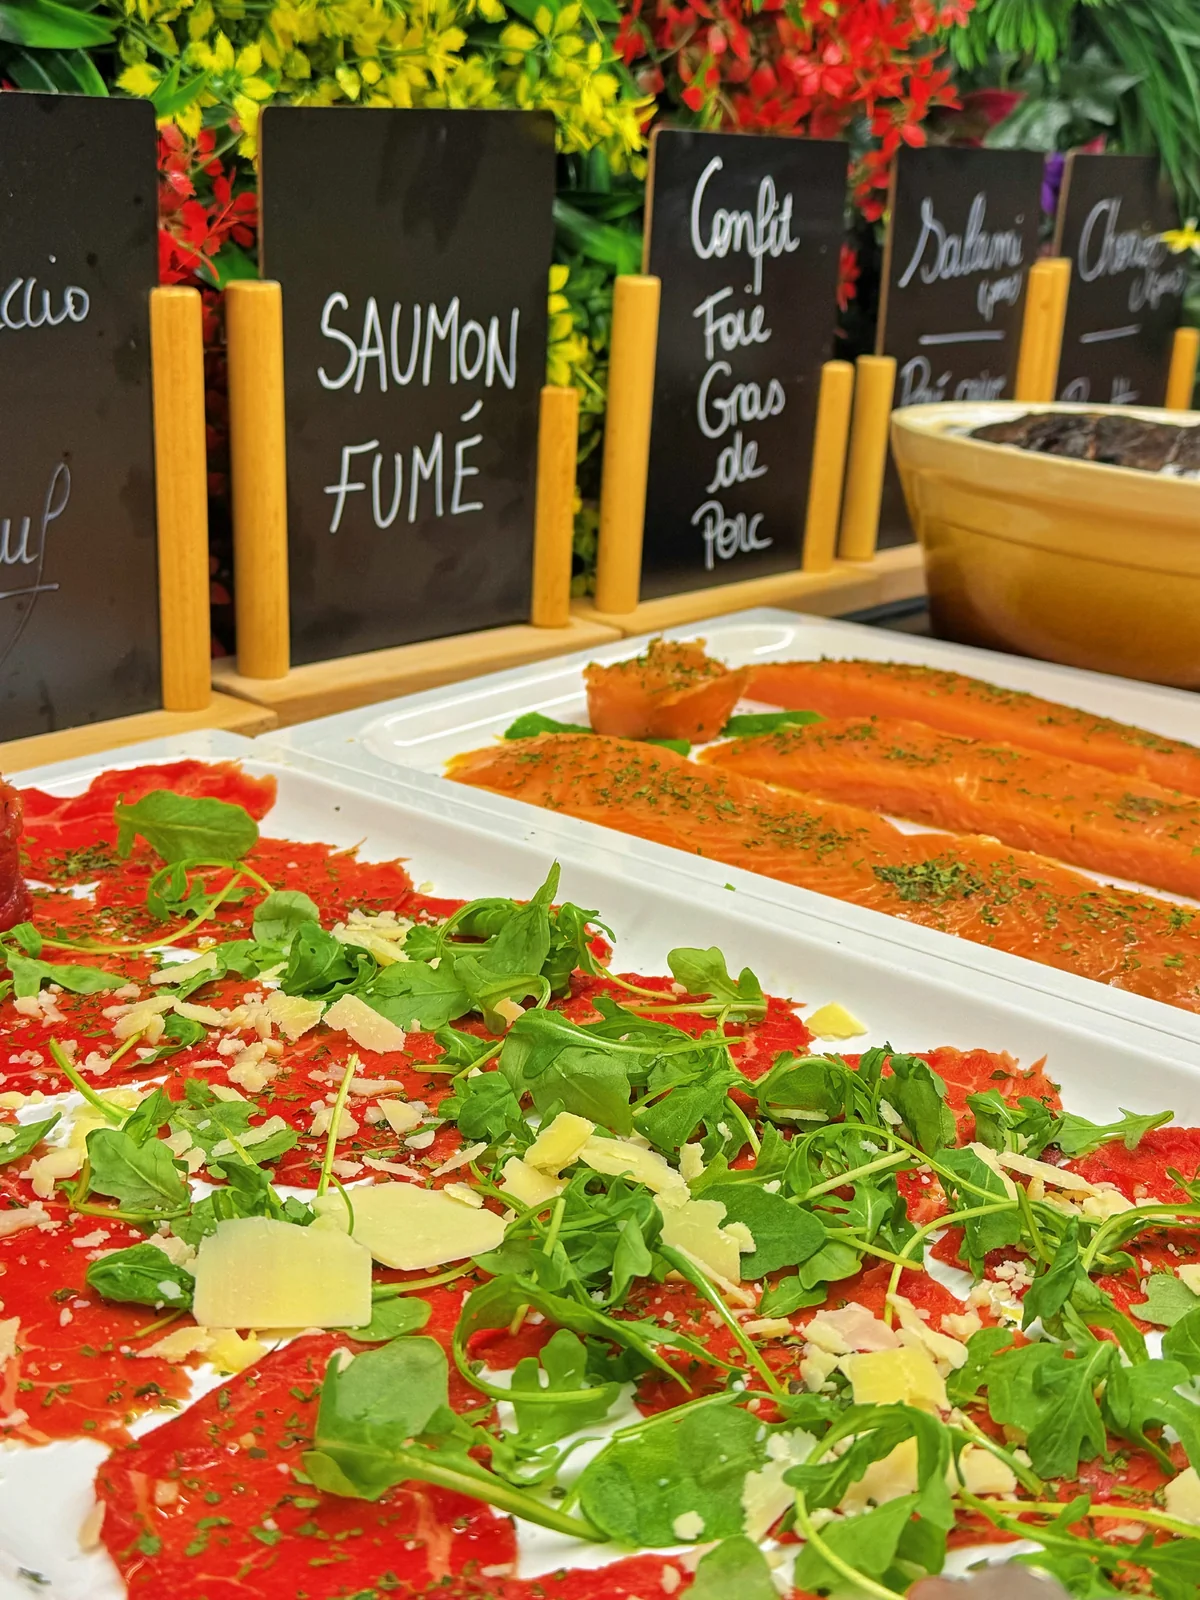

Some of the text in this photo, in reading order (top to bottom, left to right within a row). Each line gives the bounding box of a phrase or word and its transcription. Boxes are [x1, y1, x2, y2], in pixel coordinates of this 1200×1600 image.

[691, 155, 800, 296] Confit
[317, 291, 520, 394] SAUMON
[692, 286, 772, 361] Foie
[697, 360, 786, 439] Gras
[324, 399, 484, 534] FUMÉ
[706, 431, 769, 494] de
[691, 500, 774, 570] Porc
